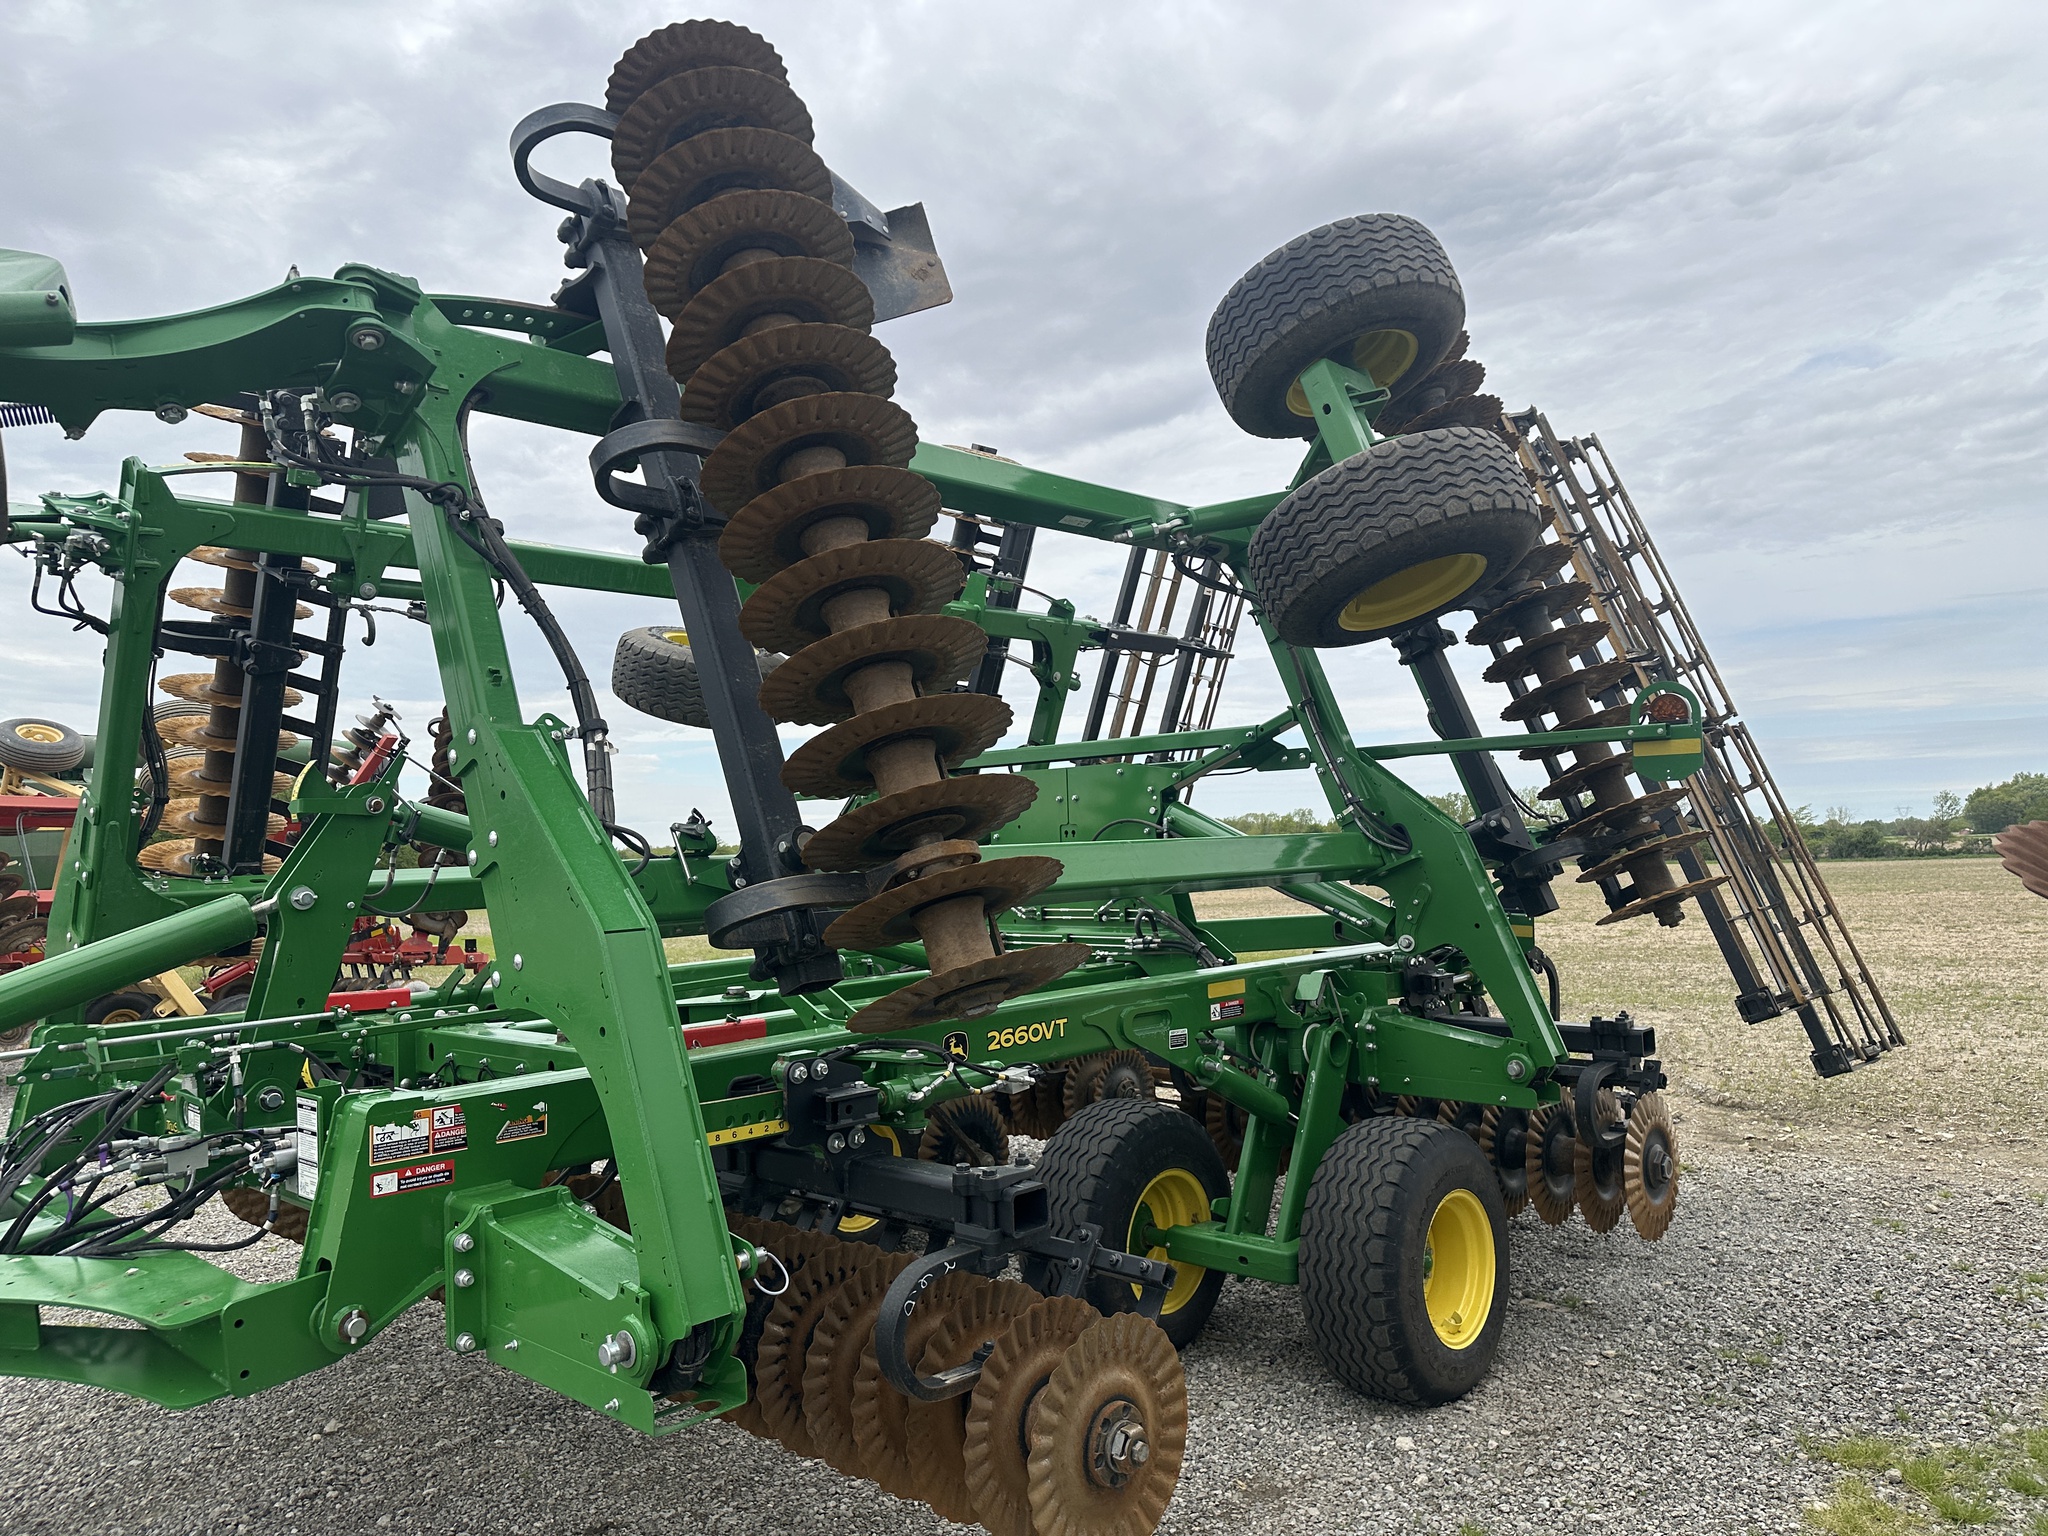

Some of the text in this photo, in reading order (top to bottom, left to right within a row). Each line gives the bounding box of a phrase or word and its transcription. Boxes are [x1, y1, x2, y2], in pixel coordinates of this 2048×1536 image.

[987, 1017, 1068, 1051] 2660VT
[441, 1127, 466, 1138] DANGE
[416, 1163, 445, 1175] DANGER
